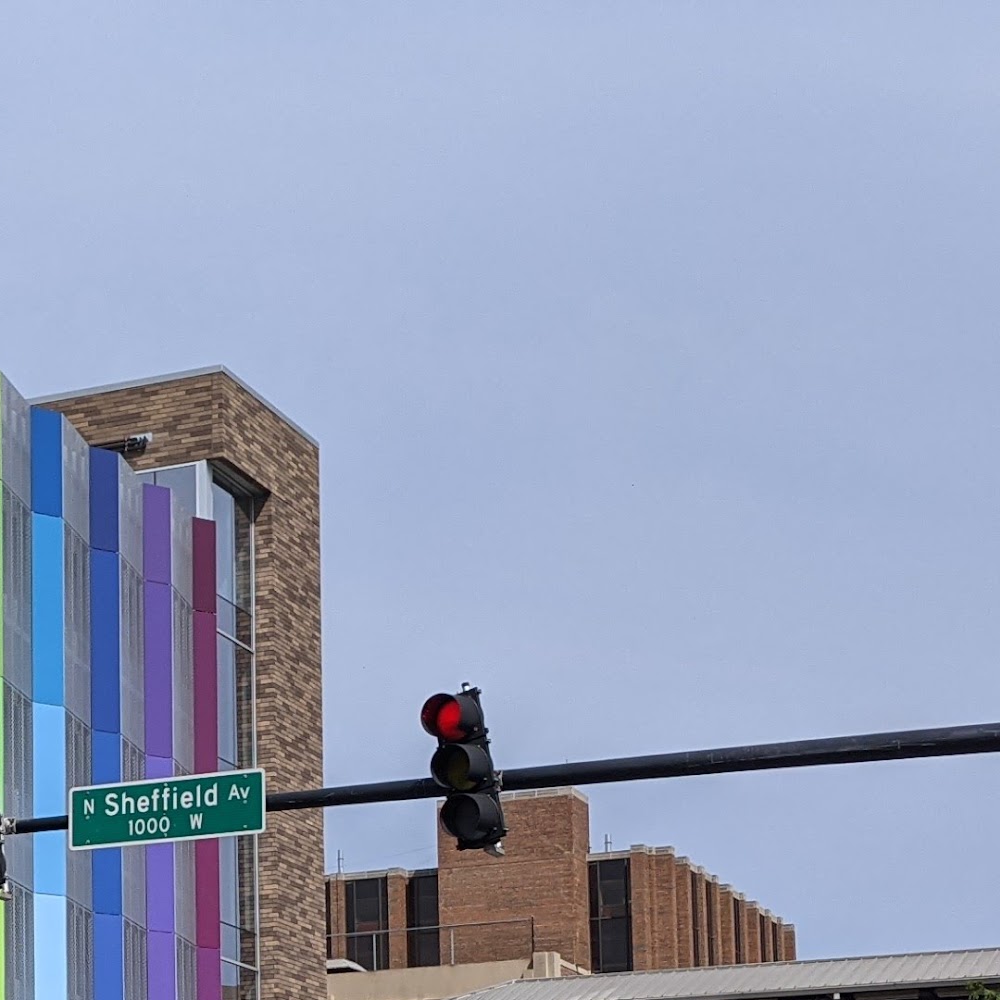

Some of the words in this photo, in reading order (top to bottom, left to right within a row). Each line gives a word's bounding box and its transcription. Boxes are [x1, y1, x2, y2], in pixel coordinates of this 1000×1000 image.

[84, 799, 95, 815] N
[104, 782, 218, 816] Sheffield
[228, 784, 250, 801] Av
[128, 816, 170, 836] 1000
[190, 813, 203, 830] W
